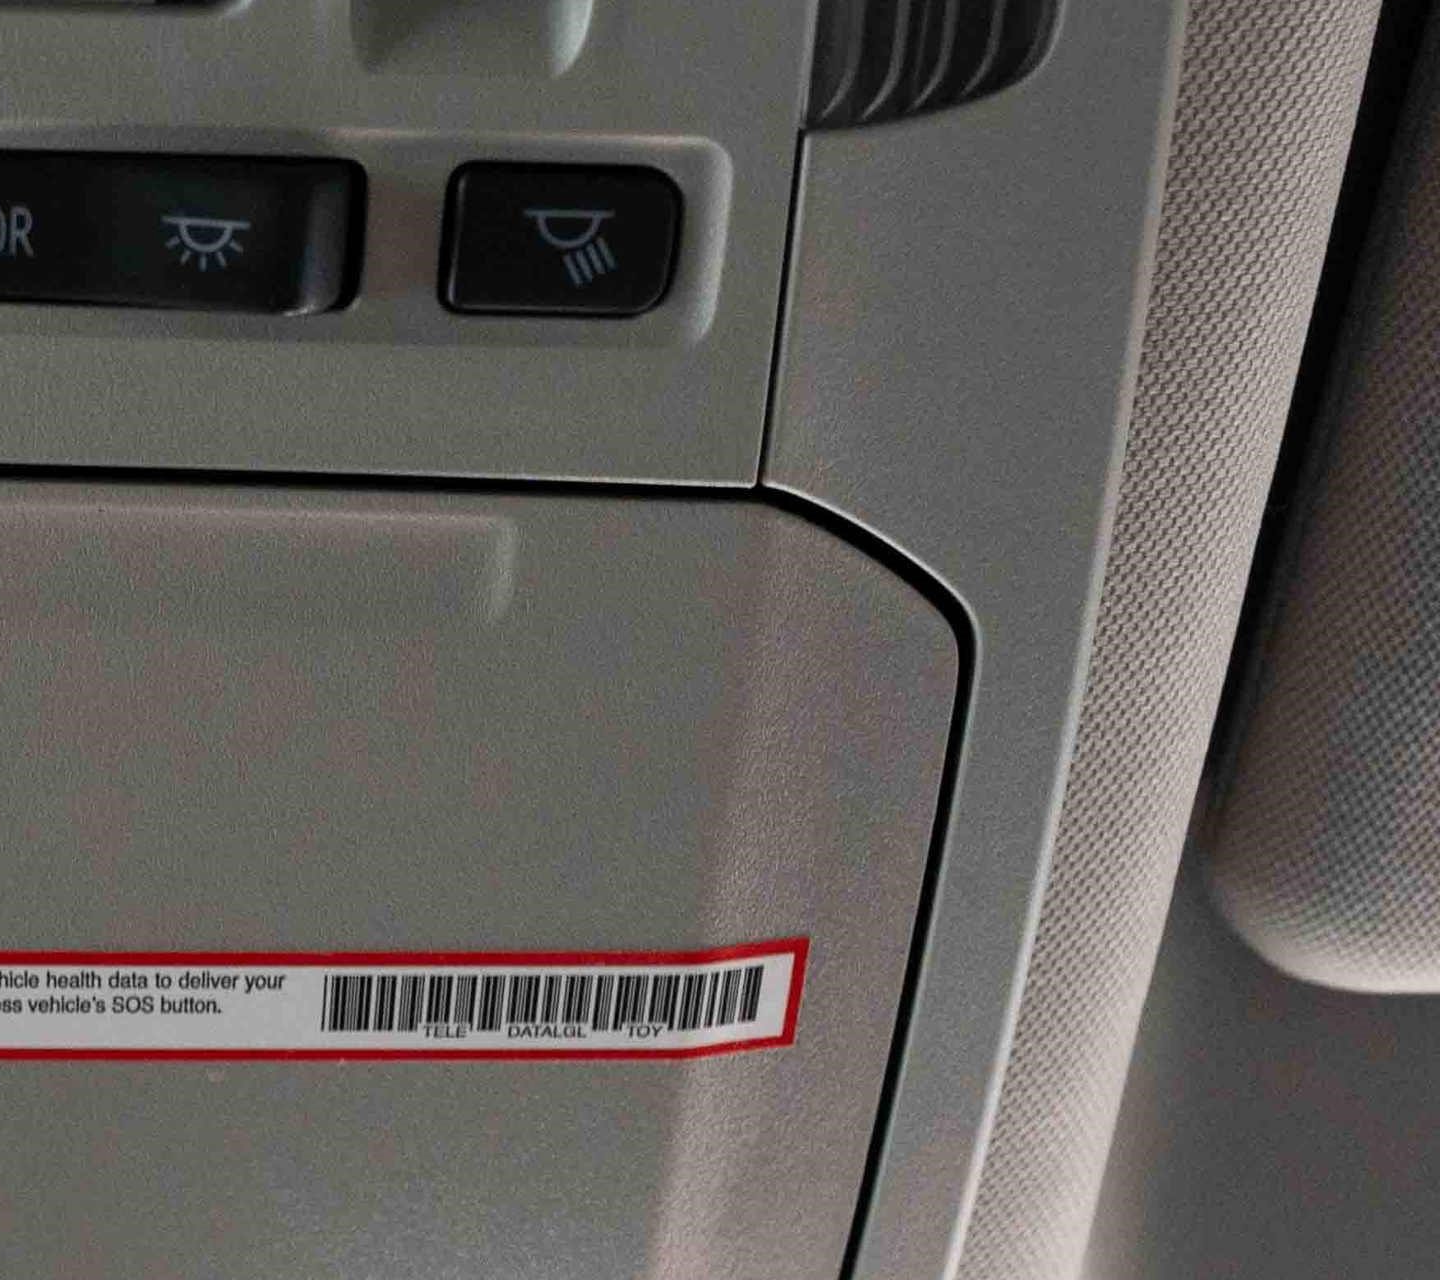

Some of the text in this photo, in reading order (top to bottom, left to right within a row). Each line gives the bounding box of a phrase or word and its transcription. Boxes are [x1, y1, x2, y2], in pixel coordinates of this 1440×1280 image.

[46, 970, 102, 990] health
[108, 970, 149, 990] data
[155, 972, 172, 990] to
[178, 971, 239, 991] deliver
[244, 974, 287, 995] your
[27, 995, 107, 1014] vehicle's
[111, 996, 155, 1015] SOS
[160, 996, 223, 1015] button.
[627, 1023, 663, 1039] TOY
